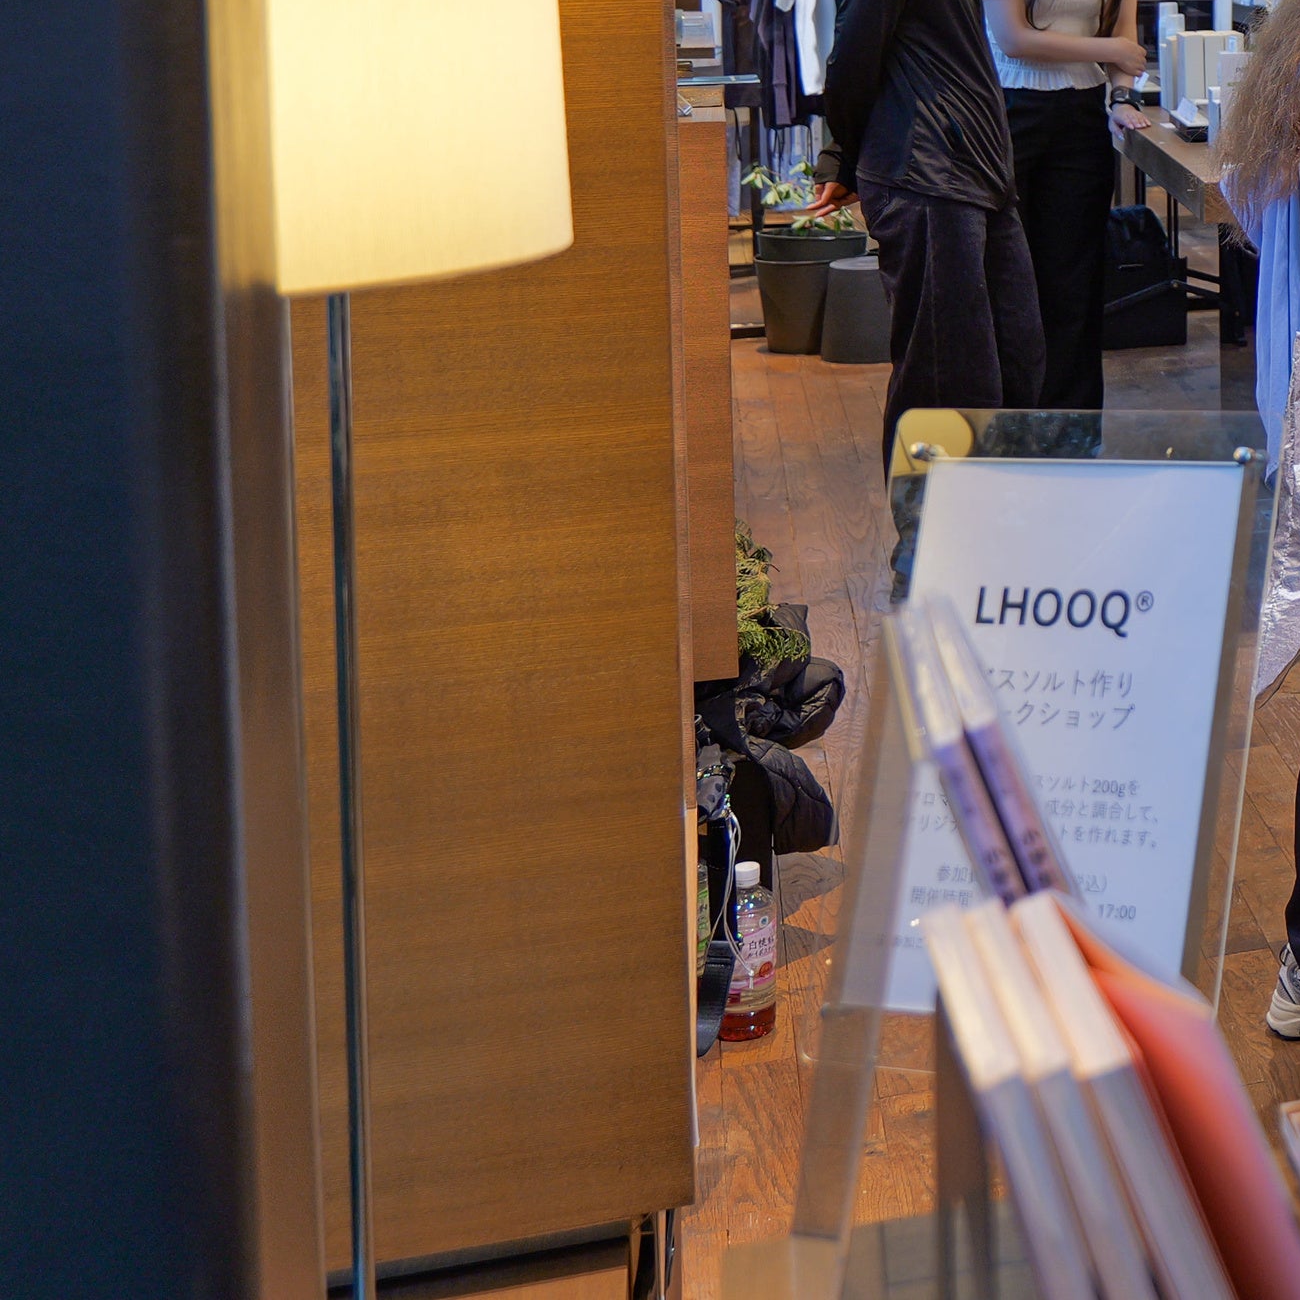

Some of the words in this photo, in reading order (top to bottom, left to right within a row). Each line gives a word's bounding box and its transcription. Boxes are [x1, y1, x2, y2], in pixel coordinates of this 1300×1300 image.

[987, 669, 1133, 698] スソルト作り
[1098, 903, 1137, 920] 17:00
